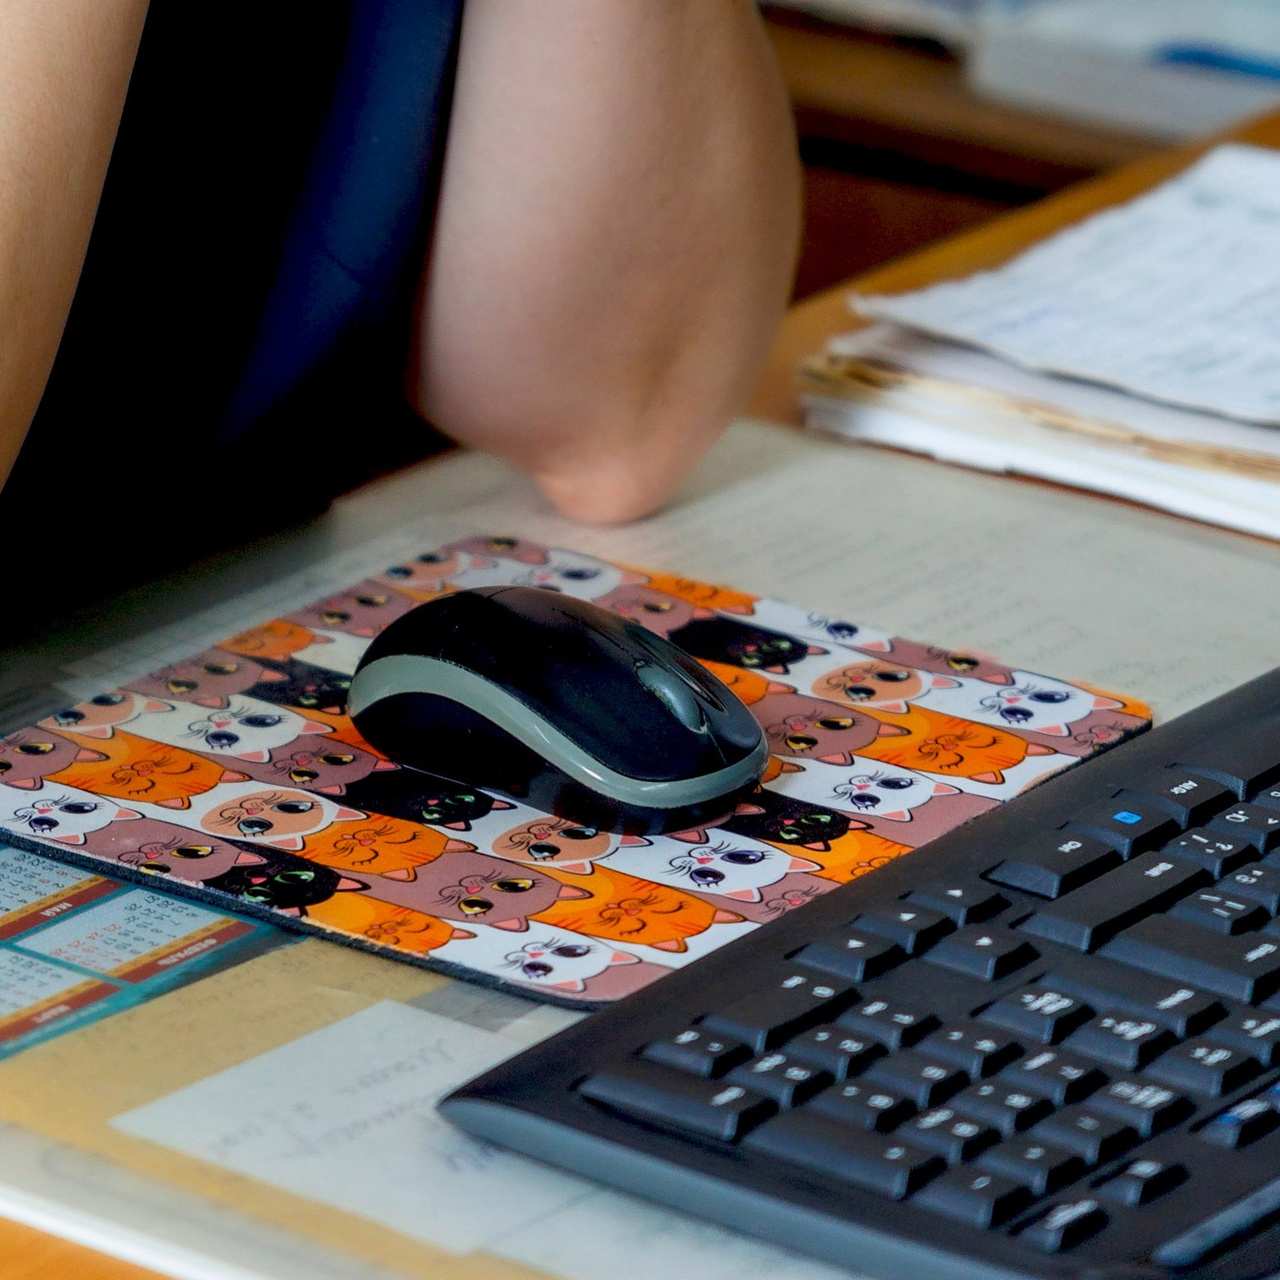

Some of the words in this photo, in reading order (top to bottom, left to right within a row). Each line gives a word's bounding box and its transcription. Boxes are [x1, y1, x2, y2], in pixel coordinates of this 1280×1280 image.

[1057, 841, 1083, 854] Ctrl
[1144, 862, 1174, 878] Shift
[40, 901, 72, 918] МАЙ
[157, 938, 218, 967] ФЕВРАЛЬ
